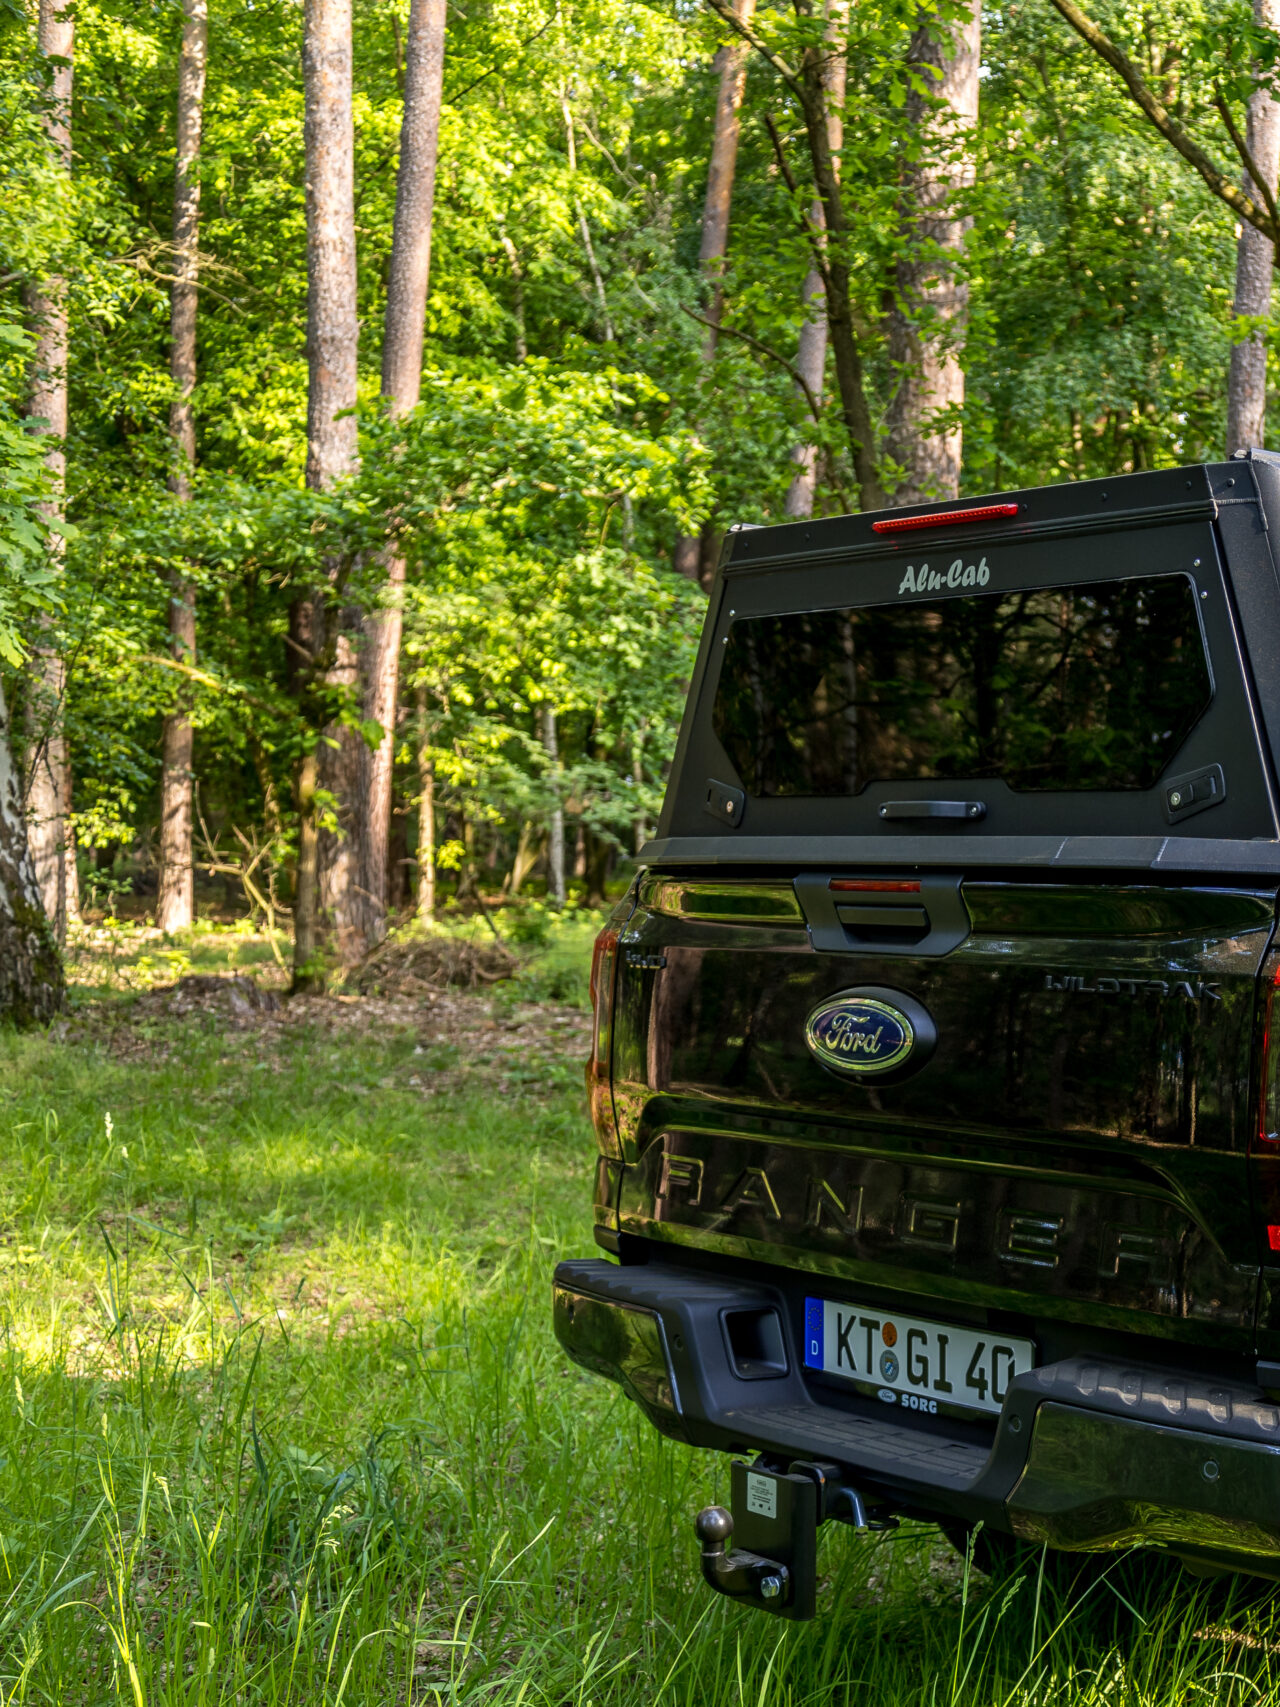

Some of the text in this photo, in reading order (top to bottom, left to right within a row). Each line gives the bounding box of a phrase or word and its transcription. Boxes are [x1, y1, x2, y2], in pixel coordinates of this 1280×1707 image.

[898, 556, 991, 594] Alu-Cab
[1045, 975, 1222, 1000] WILDTRAK
[825, 1012, 884, 1054] Ford
[654, 1151, 1174, 1287] RANGER
[811, 1340, 819, 1356] D
[837, 1312, 881, 1375] KT
[906, 1328, 953, 1393] GI
[901, 1393, 938, 1414] SORG
